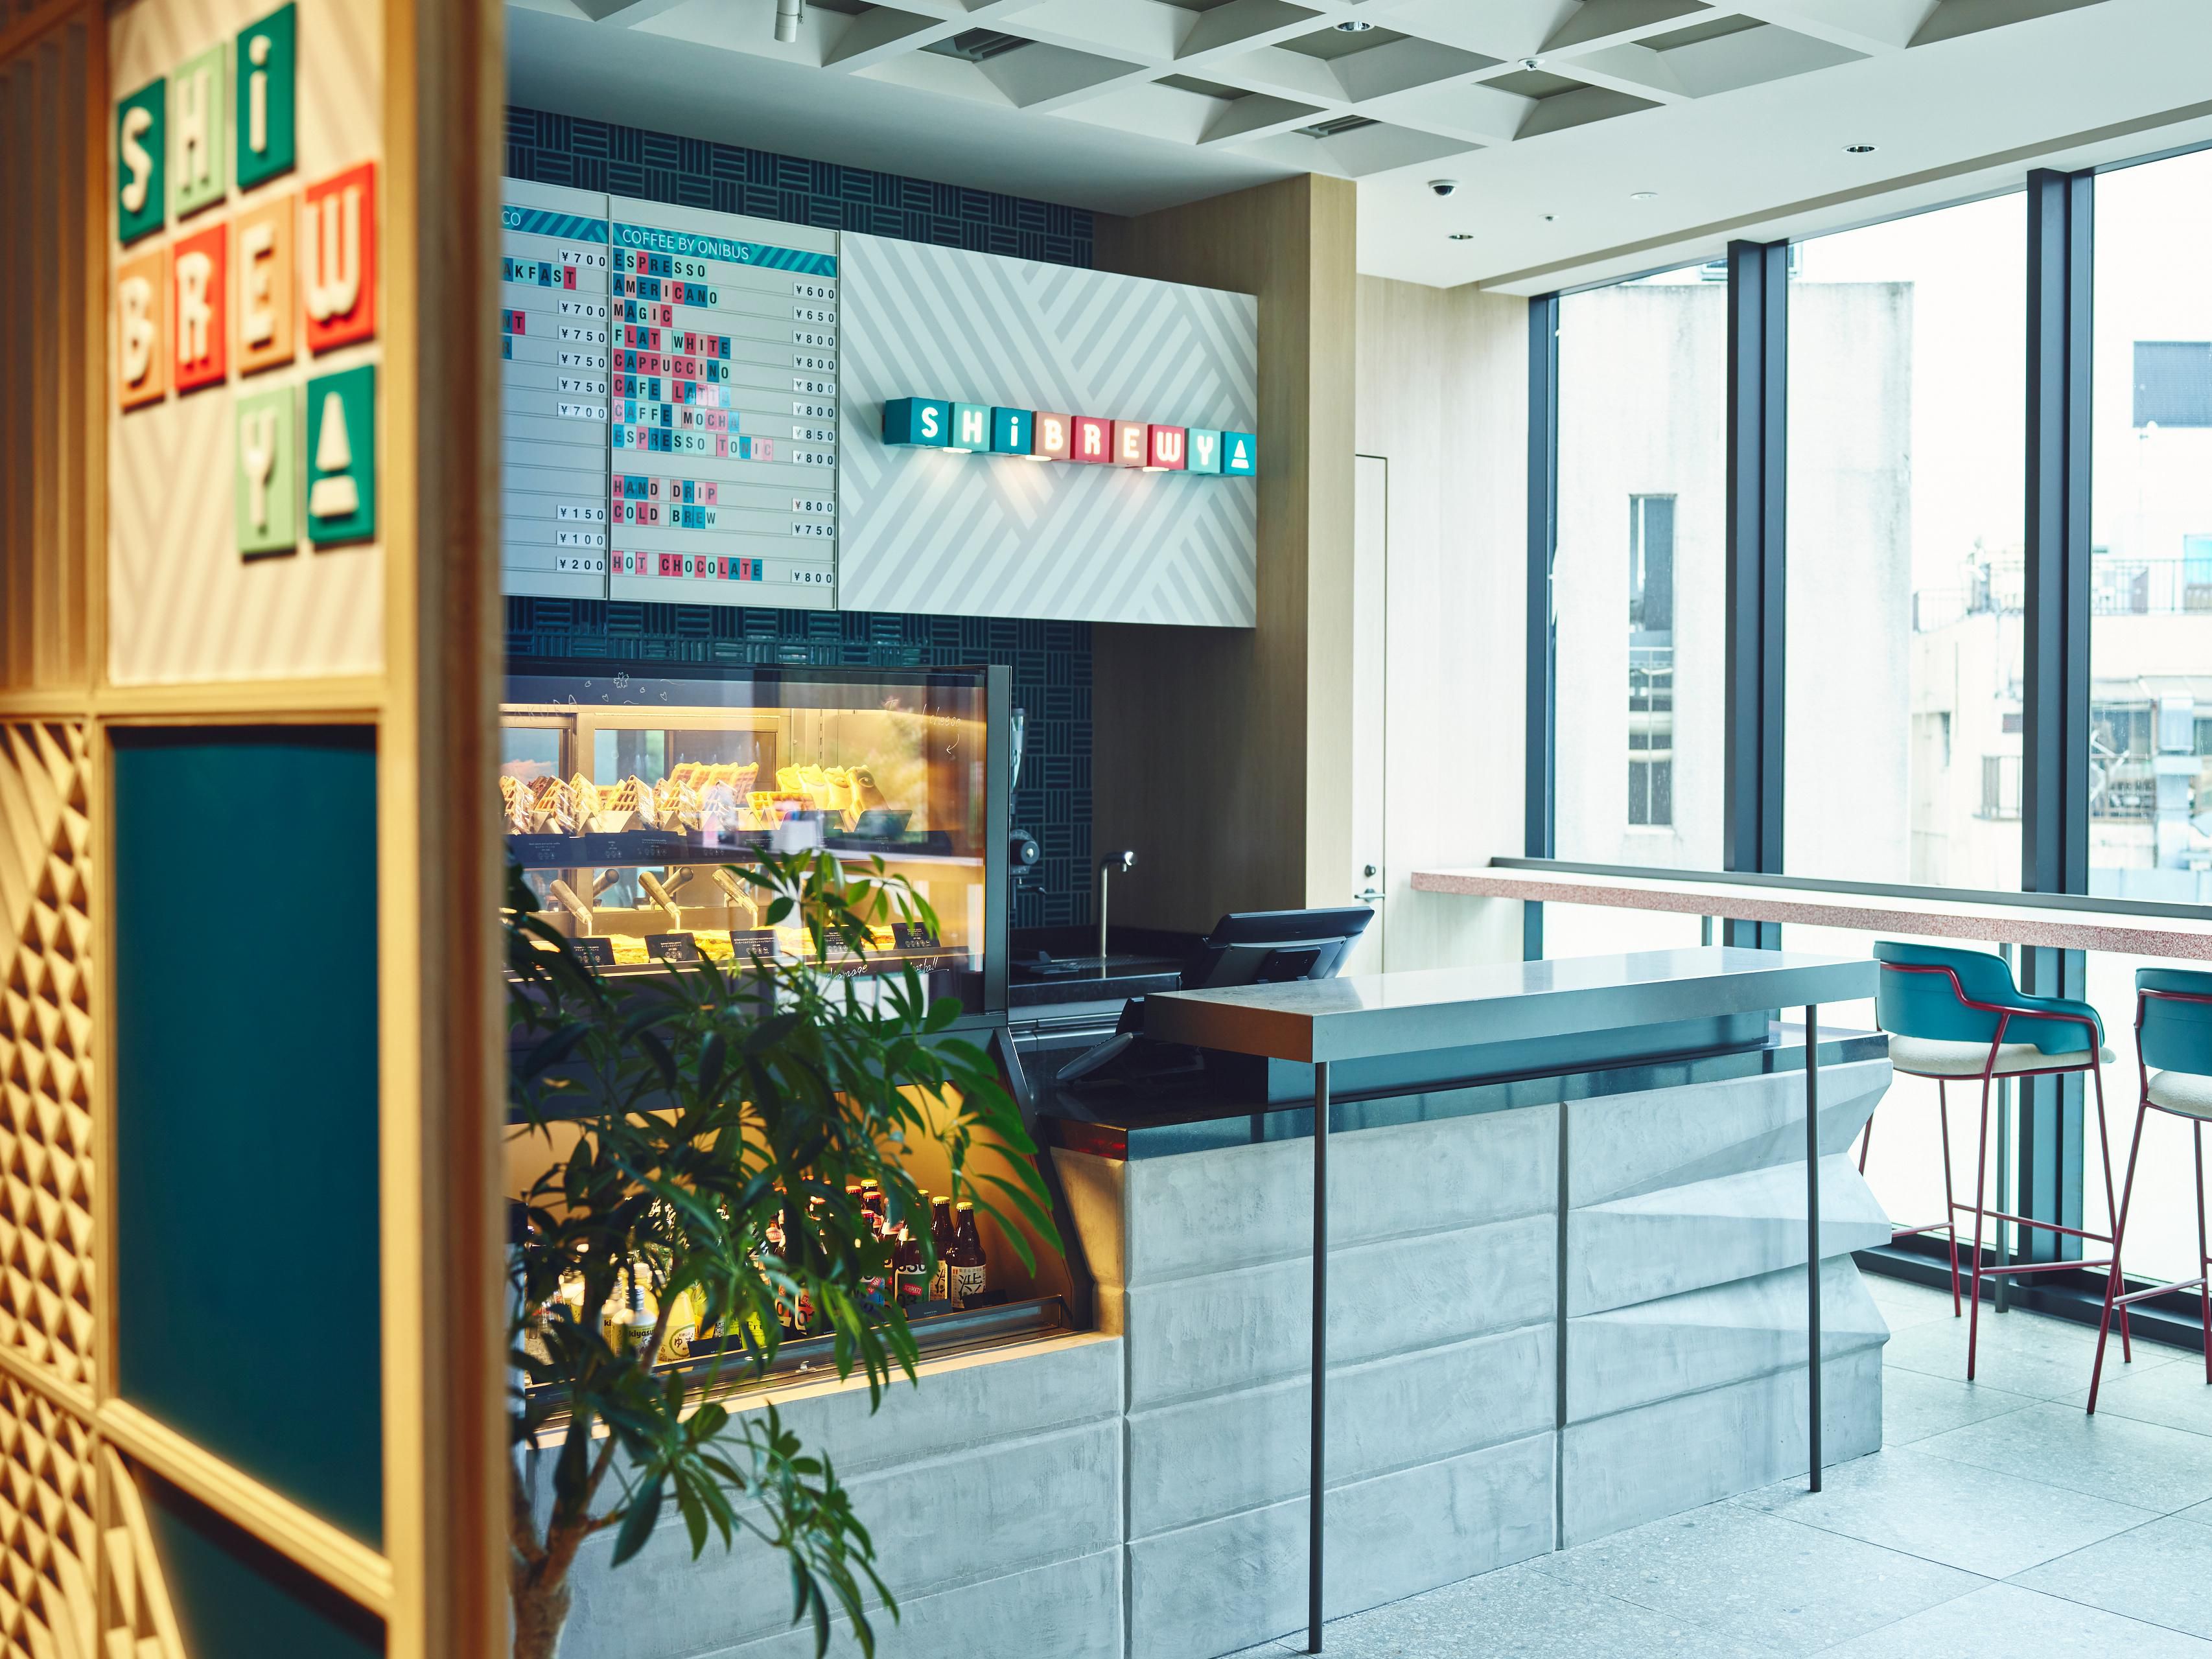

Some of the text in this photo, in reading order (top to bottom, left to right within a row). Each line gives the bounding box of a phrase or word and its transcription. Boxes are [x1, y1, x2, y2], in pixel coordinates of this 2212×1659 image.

[622, 229, 750, 260] COFFEE BY ONIBUS
[562, 251, 606, 267] ¥700
[614, 253, 706, 278] ESPRESSO
[504, 263, 574, 284] AKFAST
[119, 185, 361, 388] BREW
[614, 278, 717, 305] AMERICANO
[796, 284, 835, 299] ¥600
[561, 303, 605, 318] ¥700
[614, 303, 671, 323] MAGIC
[796, 309, 835, 323] ¥650
[561, 328, 605, 343] ¥750
[614, 329, 728, 355] FLAT WHITE
[795, 333, 835, 347] ¥800
[561, 354, 605, 369] ¥750
[614, 353, 729, 380] CAPPUCCINO
[795, 357, 835, 371] ¥800
[561, 380, 605, 394] ¥750
[614, 379, 729, 405] CAFE LATTE
[795, 381, 835, 394] ¥800
[561, 405, 605, 419] ¥700
[614, 404, 738, 428] CAFFE MOCHA
[795, 405, 834, 418] ¥800
[614, 430, 772, 455] ESPRESSO TONIC
[795, 428, 833, 442] ¥850
[795, 453, 833, 466] ¥800
[614, 480, 716, 500] HAND DRIP
[560, 507, 604, 520] ¥150
[795, 500, 833, 513] ¥800
[614, 505, 717, 525] COLD BREW
[795, 524, 833, 537] ¥750
[560, 533, 604, 546] ¥100
[559, 559, 604, 572] ¥200
[613, 555, 761, 577] HOT CHOCOLATE
[794, 571, 833, 584] ¥800
